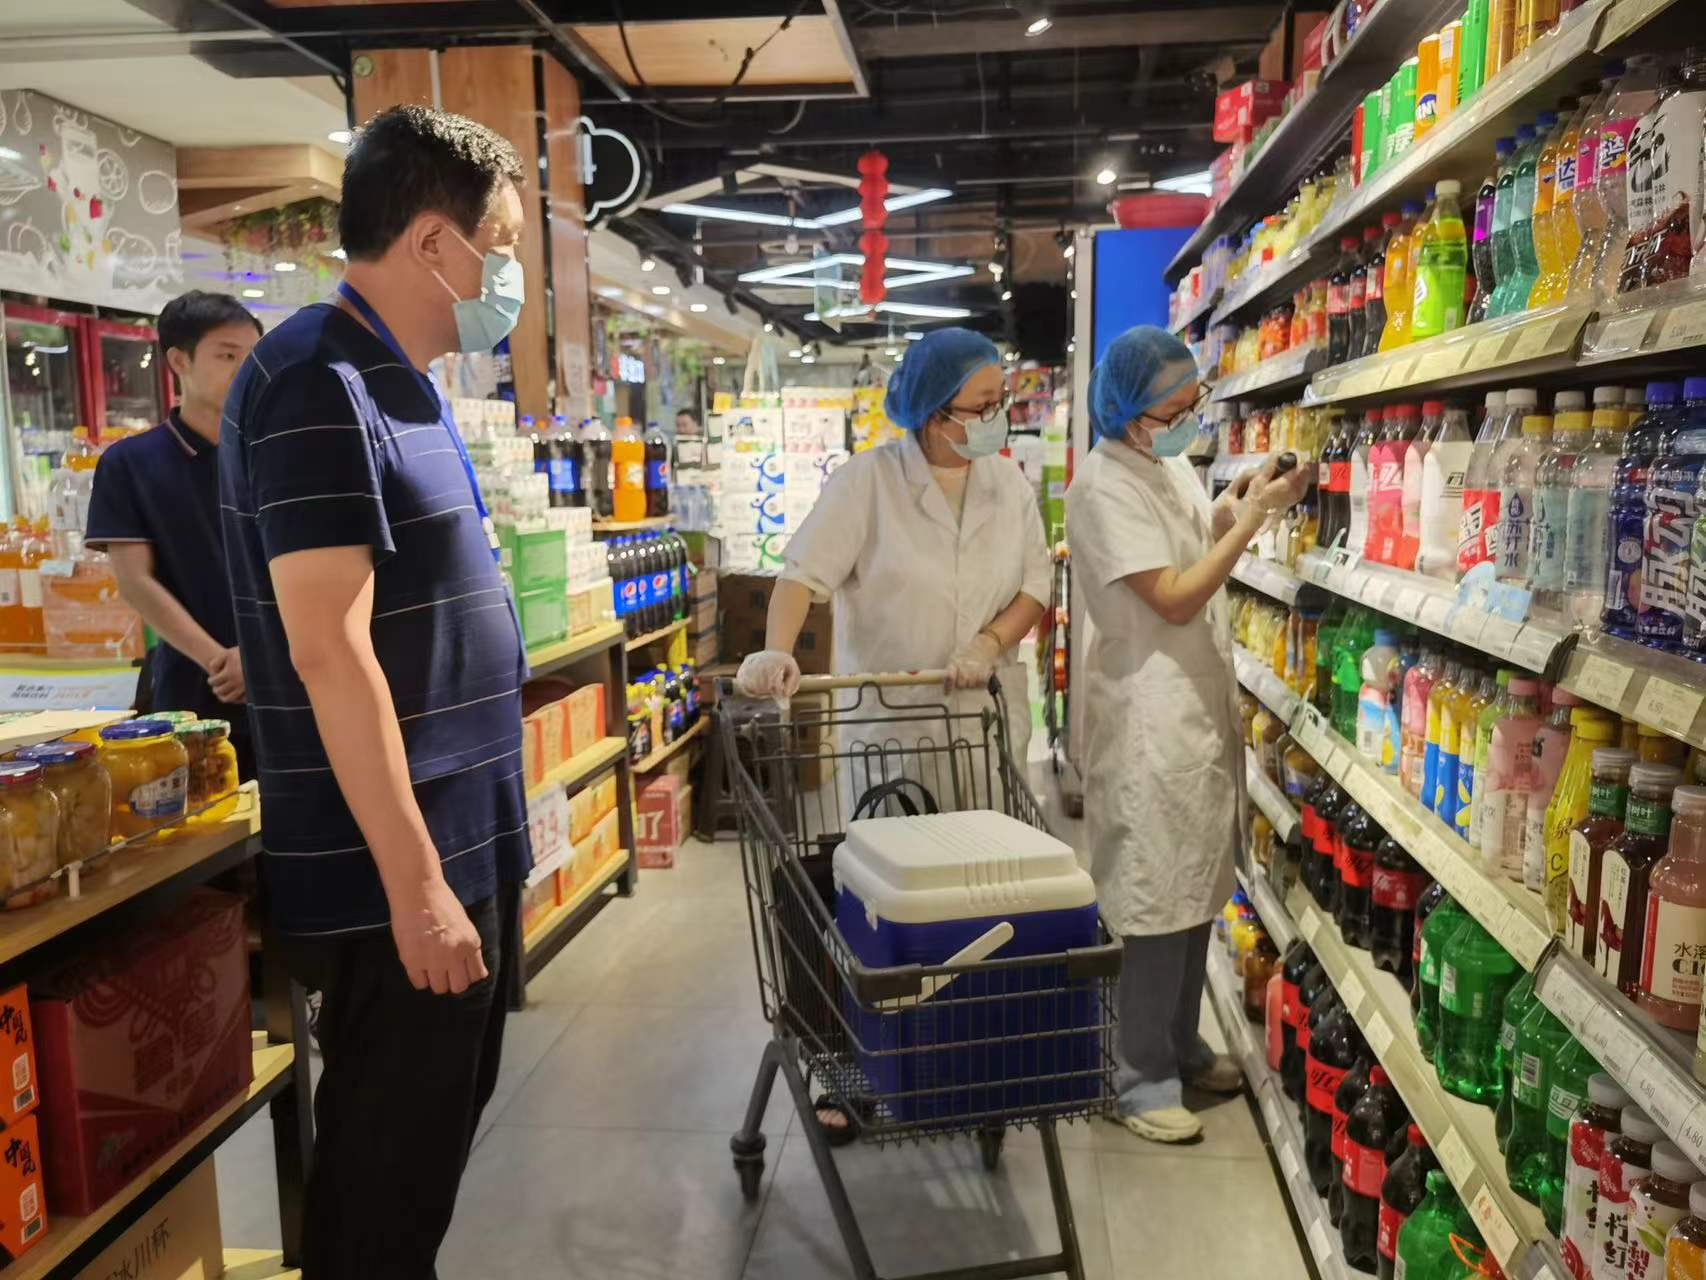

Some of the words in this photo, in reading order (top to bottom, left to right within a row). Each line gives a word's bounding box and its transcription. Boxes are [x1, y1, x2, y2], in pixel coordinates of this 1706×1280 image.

[1631, 803, 1652, 815] 树叶
[1639, 1079, 1656, 1099] 4.80
[1685, 1126, 1704, 1148] 4.80
